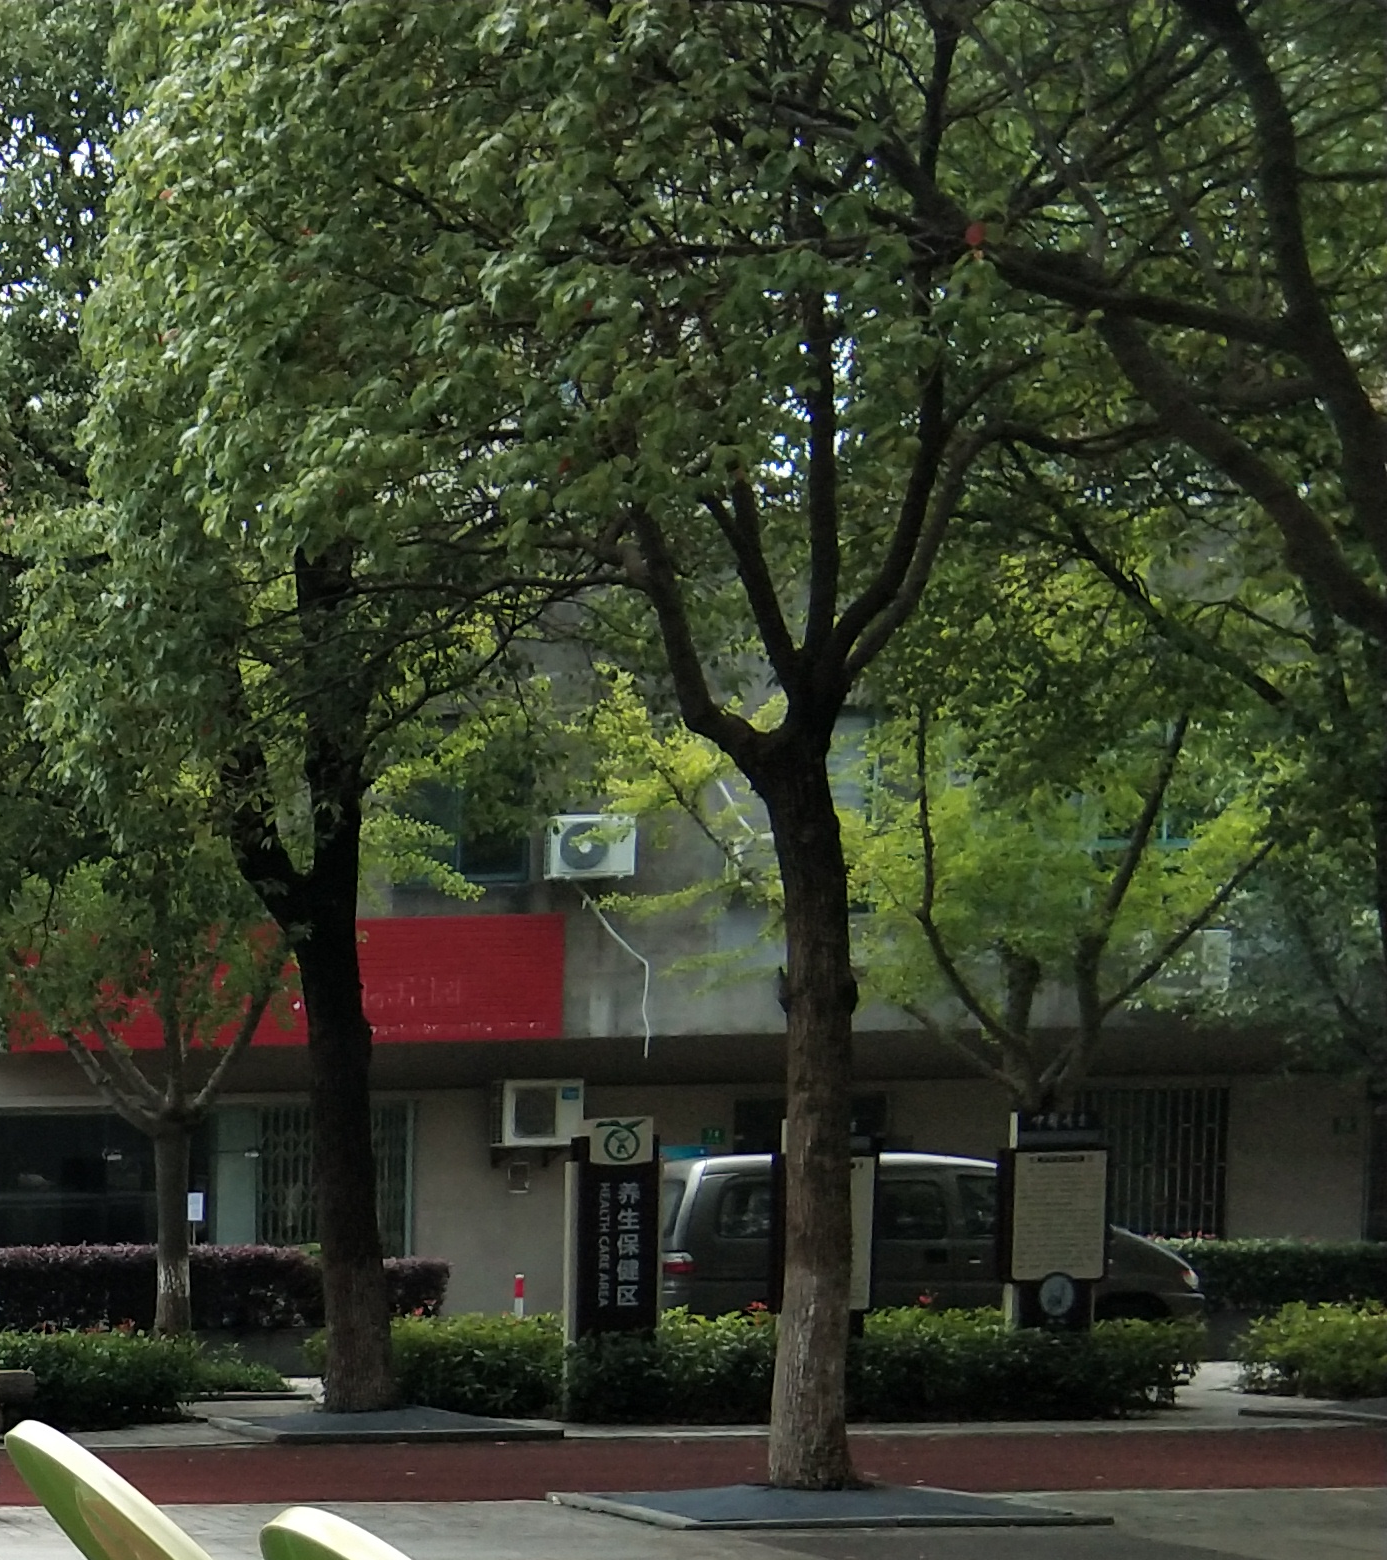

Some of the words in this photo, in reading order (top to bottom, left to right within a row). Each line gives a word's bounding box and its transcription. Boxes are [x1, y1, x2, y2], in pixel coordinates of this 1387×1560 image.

[599, 1182, 611, 1232] HEALTH
[598, 1236, 610, 1269] CARE
[616, 1182, 641, 1306] 养生保健区
[598, 1273, 609, 1308] AREA
